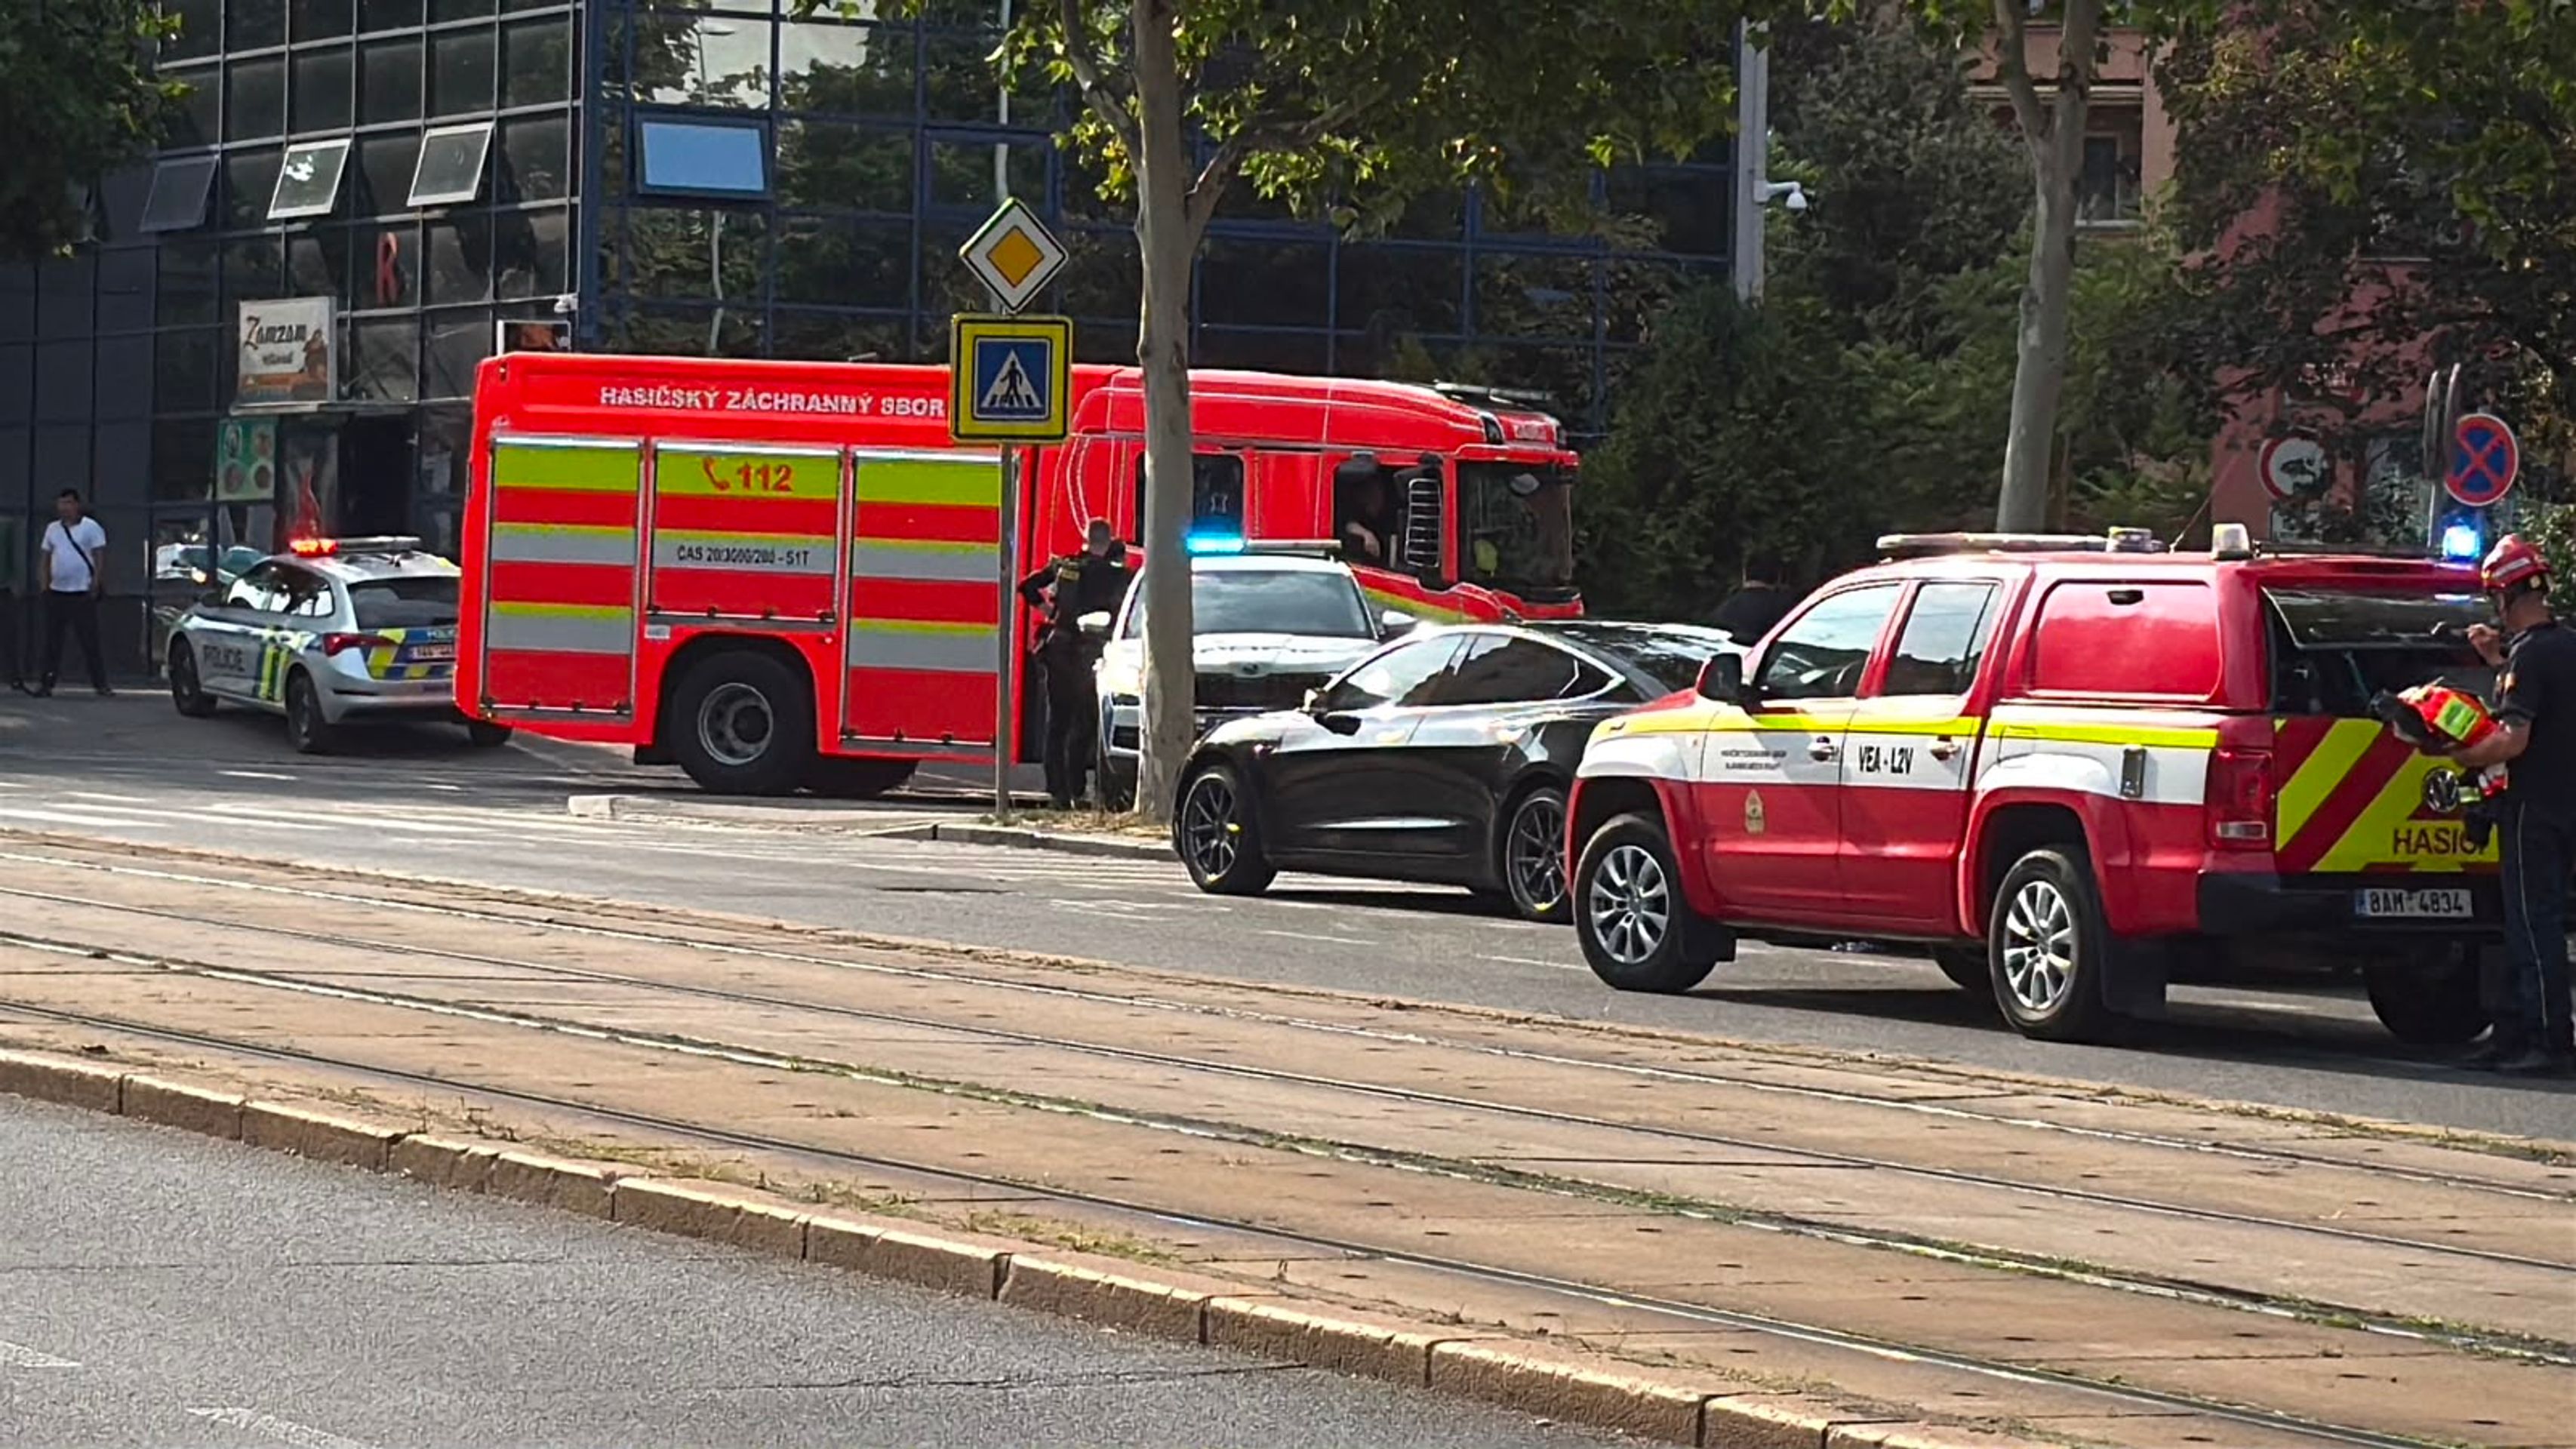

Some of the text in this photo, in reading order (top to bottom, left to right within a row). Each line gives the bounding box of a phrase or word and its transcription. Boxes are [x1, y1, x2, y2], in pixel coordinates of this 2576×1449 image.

[600, 384, 946, 417] HASIČSKÝ ZÁCHRANNÝ SBOR
[737, 461, 793, 491] 112
[1859, 746, 1881, 772] VEA
[1891, 746, 1914, 774] L2V
